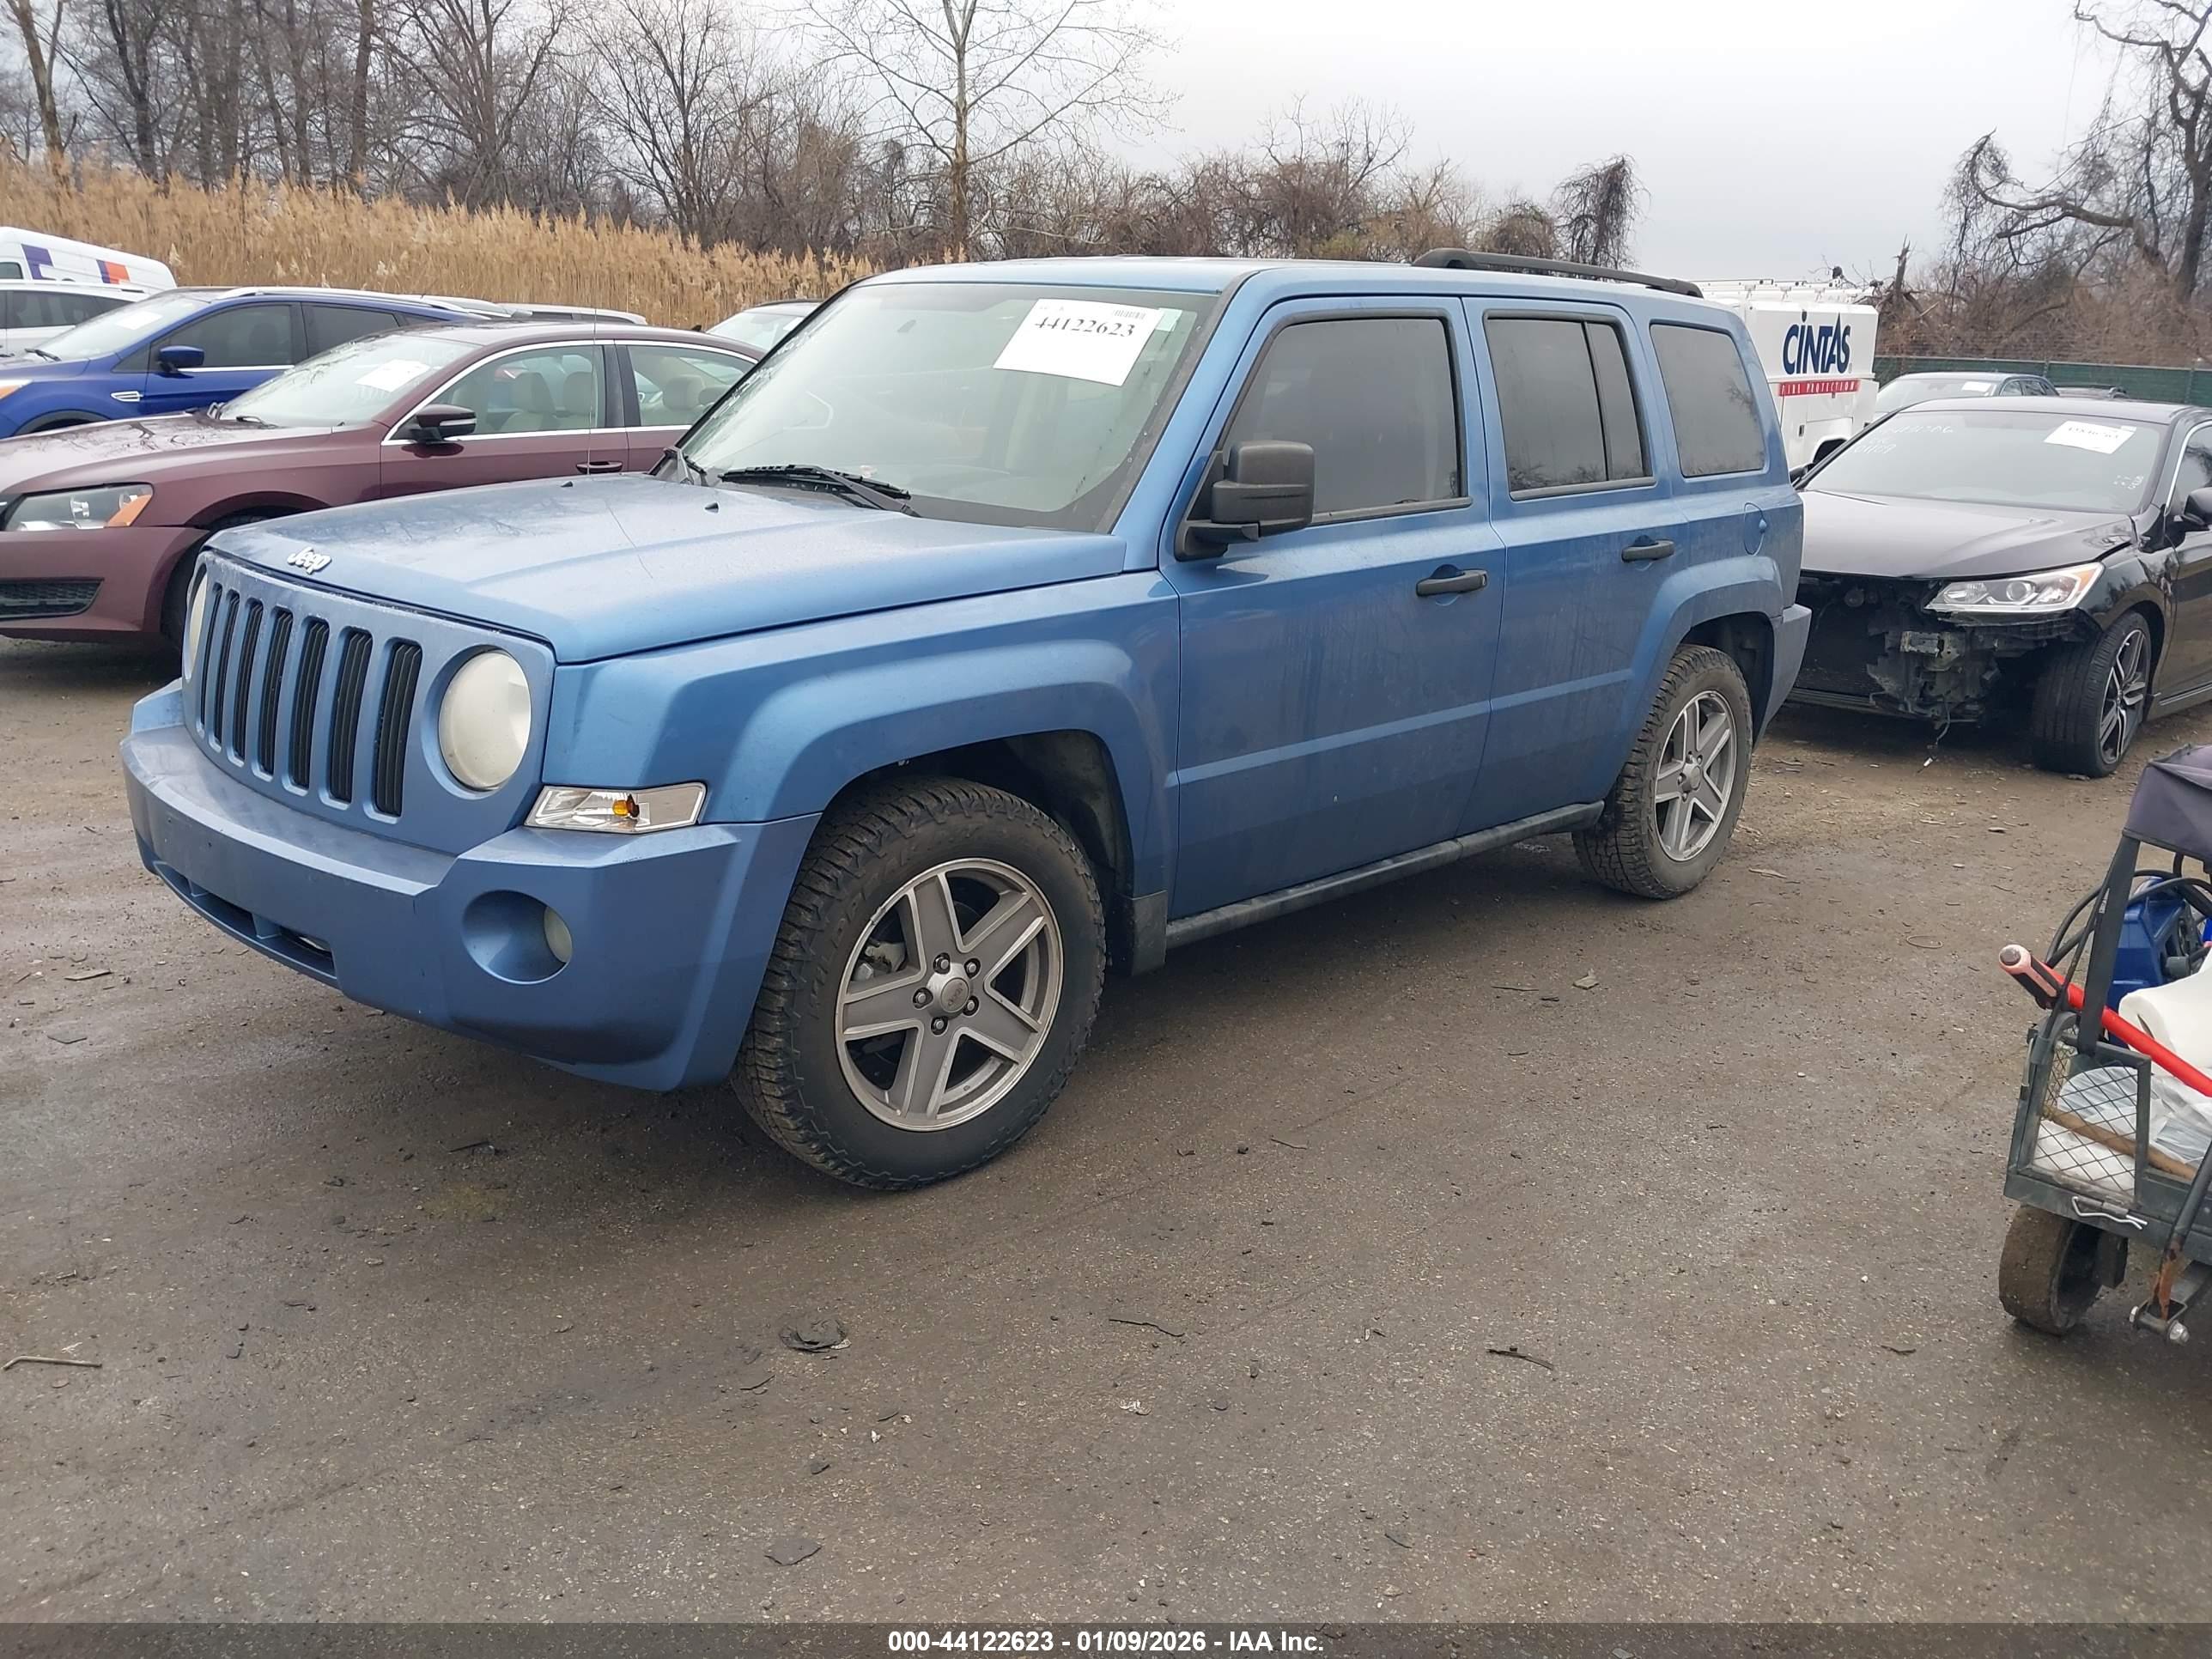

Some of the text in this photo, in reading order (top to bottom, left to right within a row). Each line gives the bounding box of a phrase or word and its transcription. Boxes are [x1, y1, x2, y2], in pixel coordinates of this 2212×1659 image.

[1035, 316, 1135, 337] 44122623
[1783, 311, 1851, 375] CINTAS
[287, 546, 332, 575] Jeep
